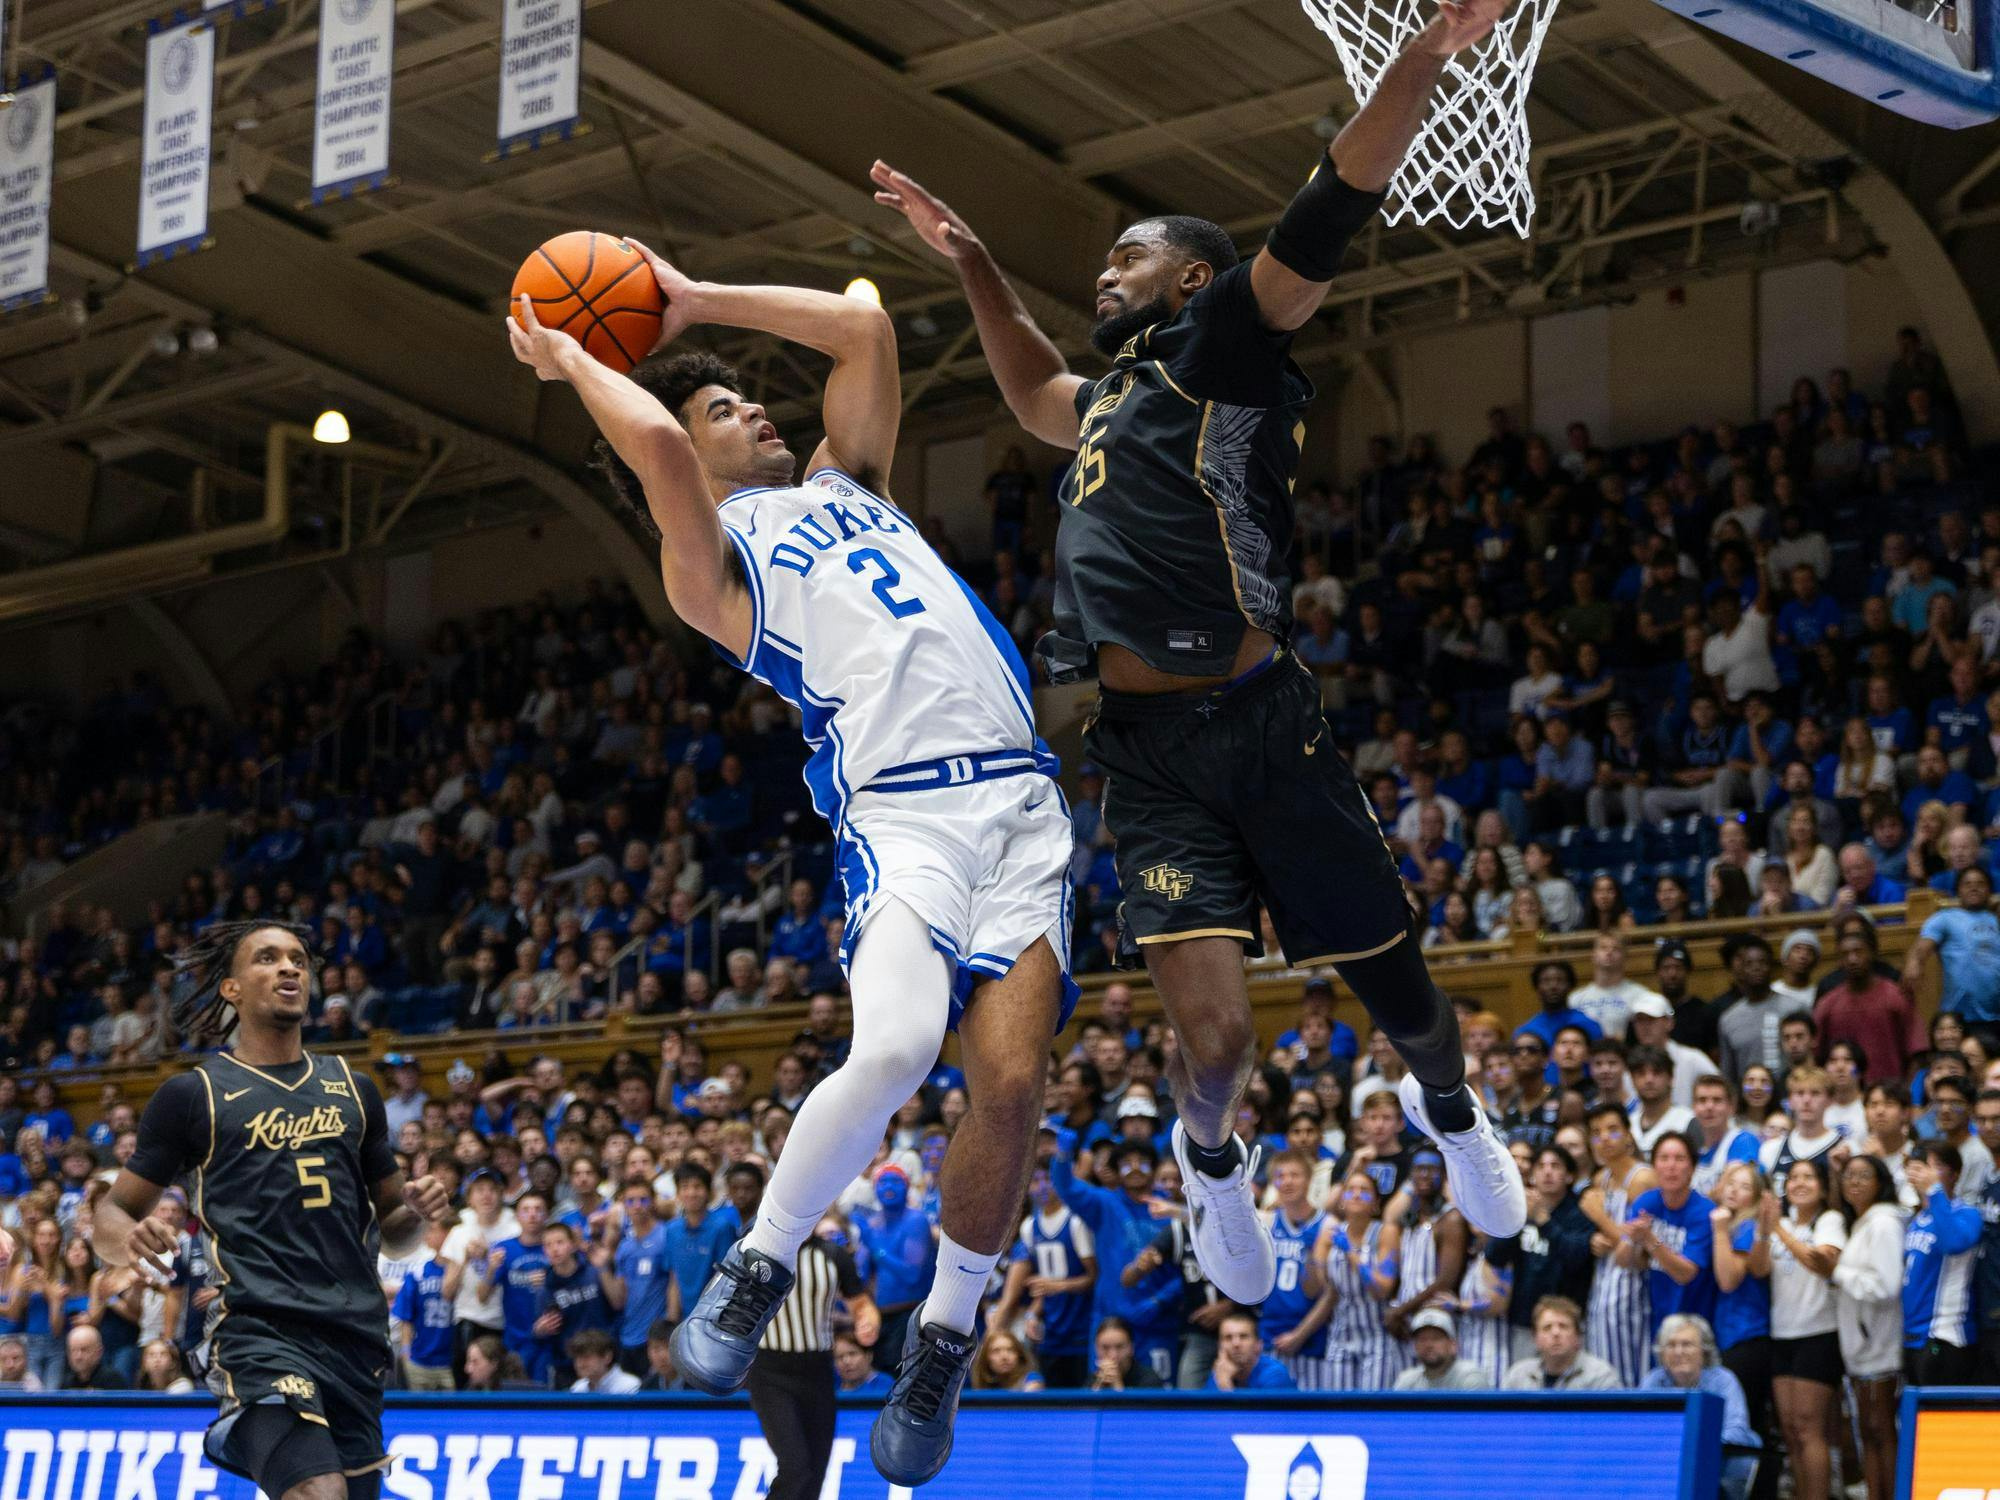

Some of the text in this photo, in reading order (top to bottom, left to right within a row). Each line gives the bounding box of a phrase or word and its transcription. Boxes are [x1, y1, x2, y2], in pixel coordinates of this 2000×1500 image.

[331, 36, 380, 63] ATLANTIC
[336, 60, 371, 82] COAST
[322, 76, 390, 106] CONFERENCE
[323, 99, 384, 128] CHAMPIONS
[1072, 425, 1107, 507] 35
[770, 502, 900, 578] DUKE
[847, 548, 926, 619] 2
[1198, 636, 1208, 646] XL
[944, 756, 974, 784] D
[1139, 863, 1193, 901] UCF
[244, 1105, 347, 1150] Knights
[295, 1156, 331, 1209] 5
[271, 1374, 315, 1399] UCF
[1, 1429, 218, 1500] DUKE
